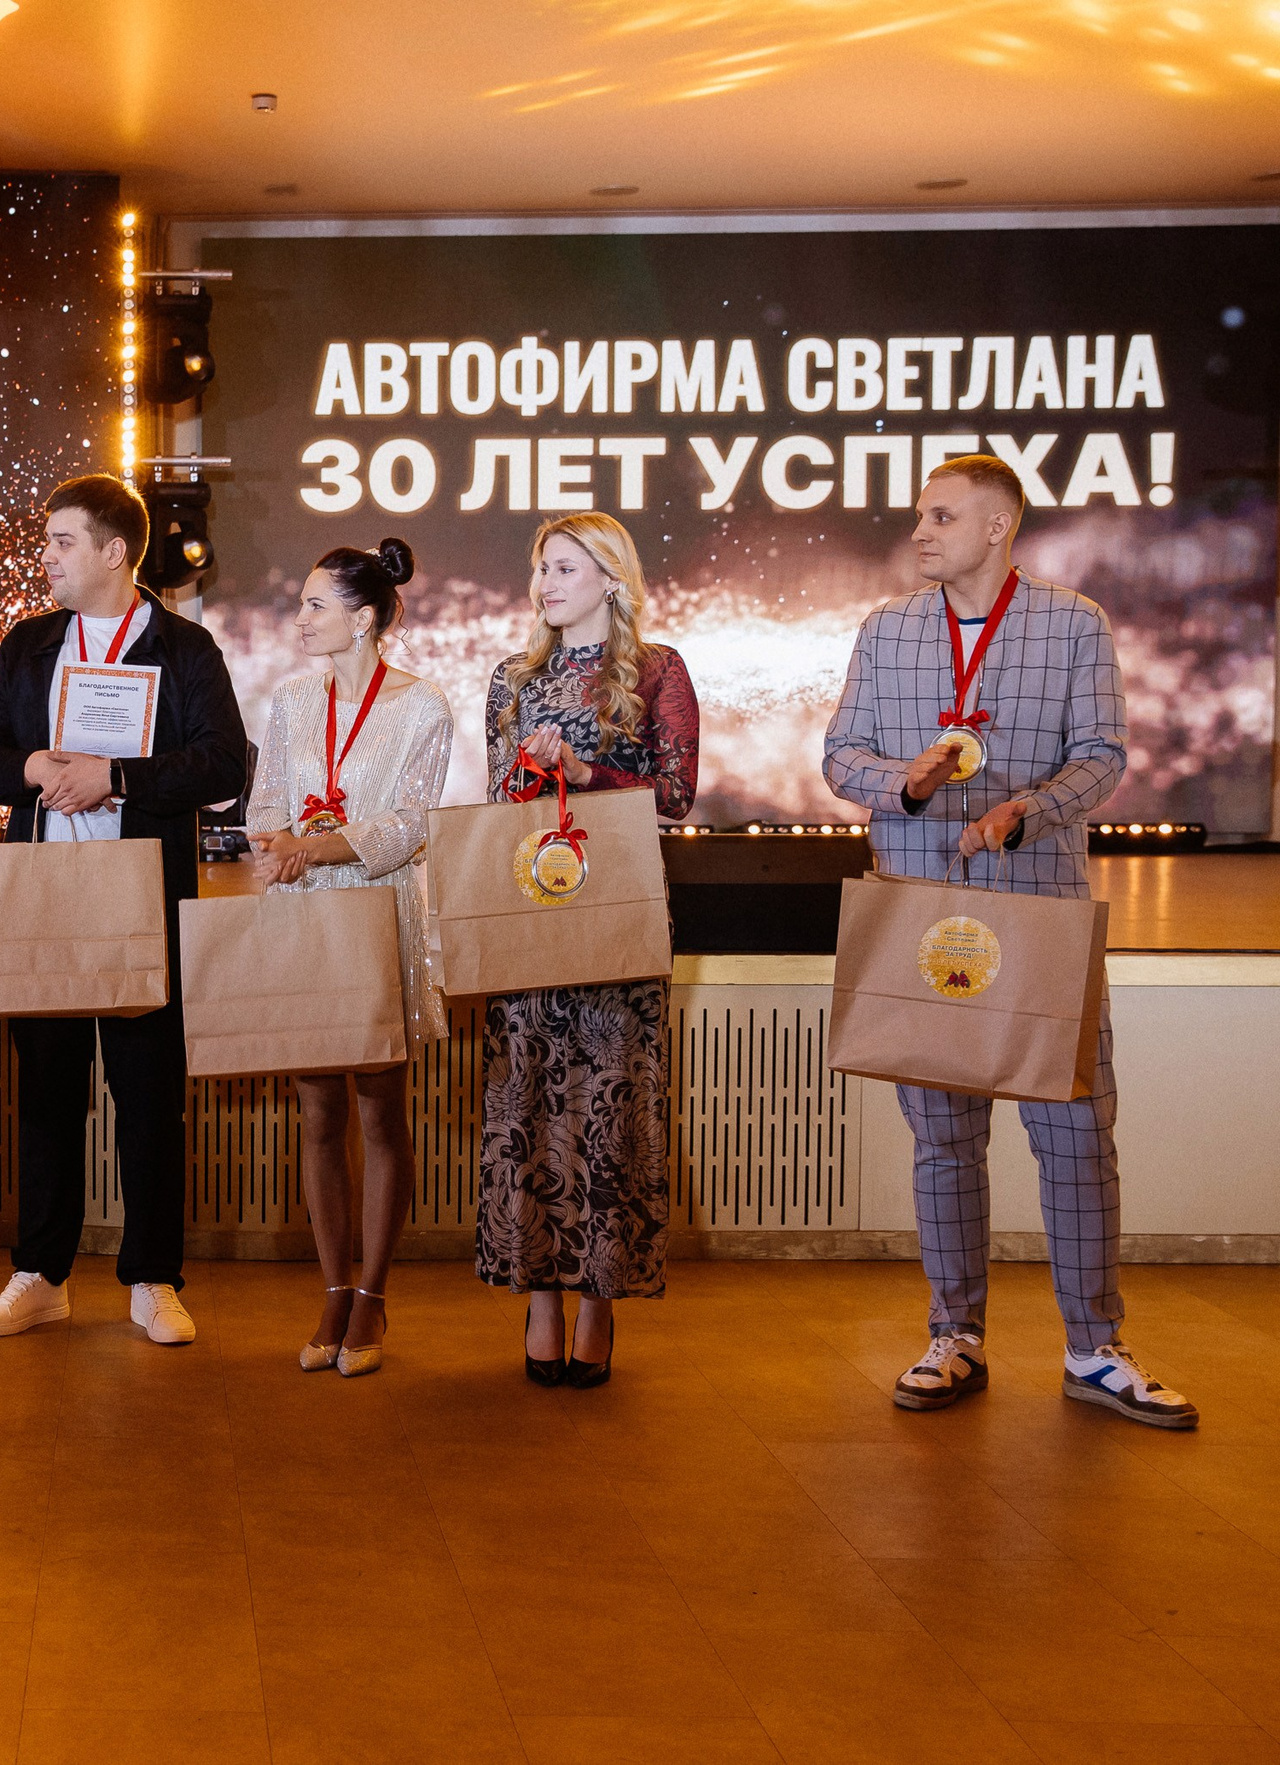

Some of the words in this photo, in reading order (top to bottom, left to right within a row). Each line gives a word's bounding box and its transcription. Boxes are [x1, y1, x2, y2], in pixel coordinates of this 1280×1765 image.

[314, 336, 766, 416] АВТОФИРМА
[787, 334, 1165, 412] СВЕТЛАНА
[300, 438, 437, 513] 30
[460, 437, 666, 511] ЛЕТ
[932, 944, 988, 953] БЛАГОДАРНОСТЬ
